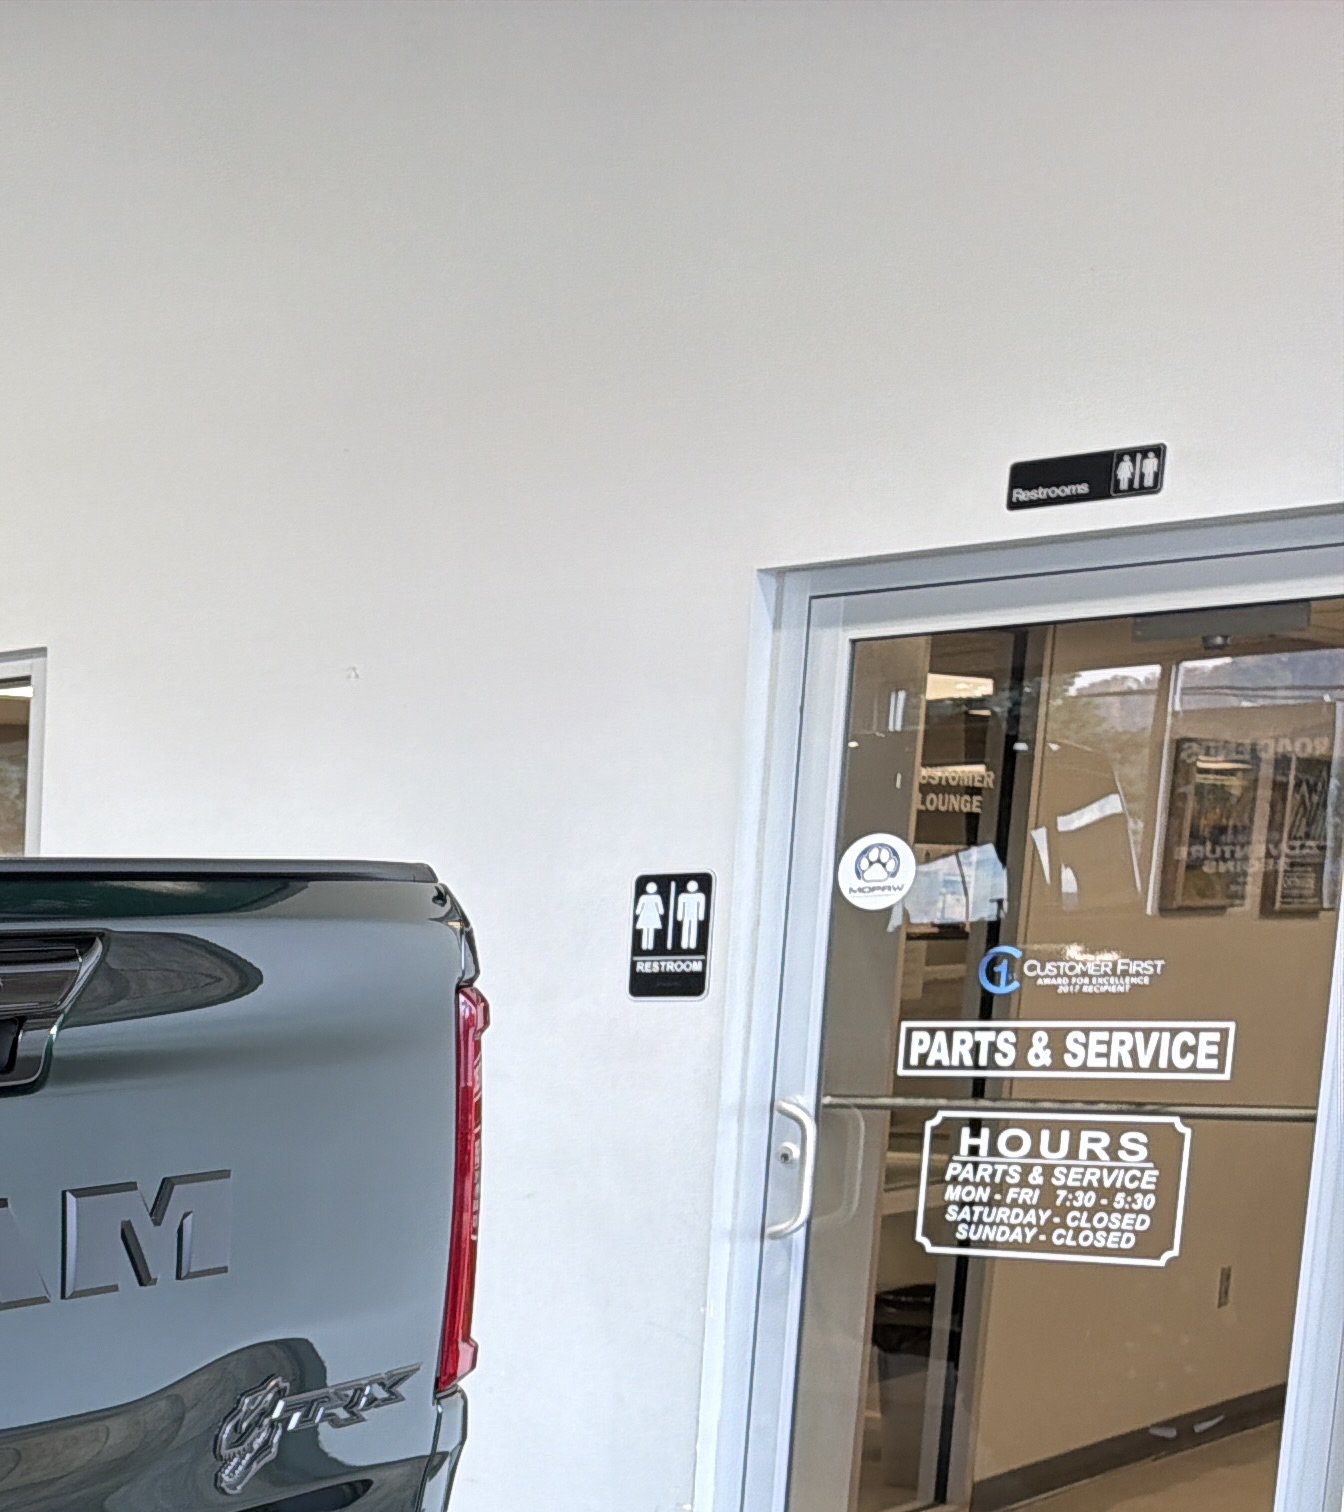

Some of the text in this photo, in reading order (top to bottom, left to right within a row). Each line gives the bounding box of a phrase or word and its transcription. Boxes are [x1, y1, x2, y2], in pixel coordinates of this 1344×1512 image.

[1012, 483, 1090, 503] Restrooms
[918, 767, 995, 789] USTOMER
[916, 792, 983, 814] LOUNGE
[636, 961, 703, 973] RESTROOM
[1023, 959, 1112, 977] CUSTOMER
[1116, 959, 1166, 975] FIRST
[1036, 976, 1150, 985] AWARD FOR EXCELLENCE
[1082, 984, 1131, 993] RECIPIENT
[909, 1030, 1221, 1069] PARTS & SERVICE
[960, 1127, 1149, 1162] HOURS
[945, 1163, 1159, 1189] PARTS & SERVICE
[945, 1185, 990, 1202] MON
[1006, 1188, 1040, 1204] FRI
[1056, 1190, 1096, 1207] 7:30
[1113, 1192, 1155, 1210] 5:30
[945, 1205, 1052, 1226] SATURDAY
[1066, 1211, 1150, 1231] CLOSED
[956, 1225, 1038, 1243] SUNDAY
[1051, 1230, 1136, 1249] CLOSED
